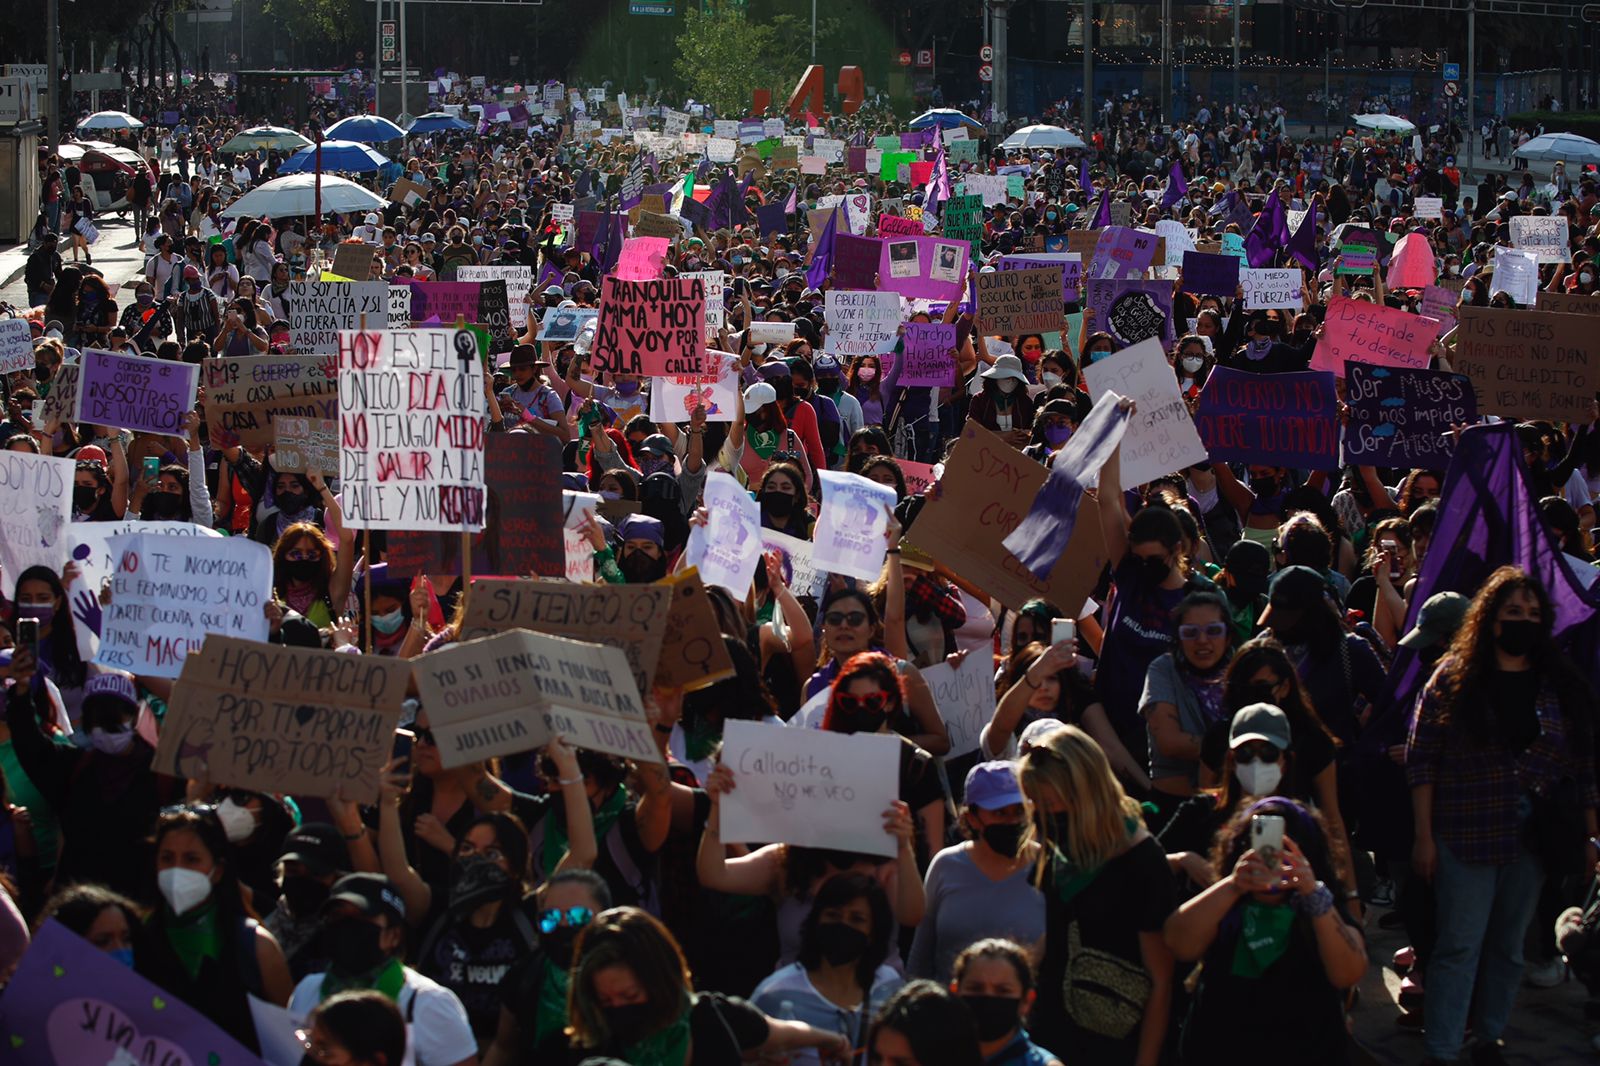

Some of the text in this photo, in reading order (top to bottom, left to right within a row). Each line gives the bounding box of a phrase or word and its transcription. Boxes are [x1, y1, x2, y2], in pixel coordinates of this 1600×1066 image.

[290, 281, 351, 297] NO SOY TU
[607, 276, 704, 303] TRANQUILA
[979, 273, 1019, 290] QUIERO
[291, 296, 356, 315] MAMACITA
[834, 294, 876, 307] ABUELITA
[1024, 299, 1063, 314] LOGROS
[1253, 290, 1291, 304] FUERZA
[290, 315, 354, 330] LO FUERA TE
[660, 302, 701, 329] HOY
[834, 308, 857, 320] VINE
[857, 308, 864, 320] A
[1340, 303, 1415, 343] Defiende
[597, 323, 618, 349] NO
[676, 329, 699, 346] POR
[906, 324, 953, 343] Marcho
[1504, 319, 1555, 341] CHISTES
[338, 331, 456, 371] HOY ES EL
[593, 346, 703, 374] SOLA CALLE
[682, 344, 696, 358] LA
[1531, 344, 1549, 361] NO
[1556, 346, 1588, 365] DAN
[1350, 367, 1383, 402] Ser
[1496, 363, 1586, 388] CALLADITO
[246, 384, 276, 403] CASA
[285, 382, 296, 398] Y
[302, 381, 321, 396] EN
[340, 370, 481, 413] ÚNICO DÍA QUE
[92, 400, 112, 420] DE
[223, 410, 260, 431] CASA
[1379, 407, 1407, 426] nos
[1413, 403, 1466, 428] impide
[342, 413, 368, 449] NO
[371, 412, 434, 449] TENGO
[434, 414, 485, 453] MIEDO
[1347, 423, 1385, 455] Ser
[342, 449, 483, 483] DE SALIR A LA
[971, 447, 1032, 495] STAY
[341, 483, 437, 522] CALLE Y NO
[118, 550, 139, 573] NO
[152, 552, 173, 573] TE
[114, 579, 130, 595] EL
[234, 589, 258, 608] NO
[488, 588, 622, 626] SI TENGO
[200, 612, 225, 630] QUE
[105, 627, 142, 649] FINAL
[217, 647, 388, 709] HOY MARCHO
[432, 668, 457, 689] YO
[464, 663, 483, 681] SI
[495, 652, 552, 676] TENGO
[443, 677, 522, 709] OVARIOS
[533, 674, 575, 700] PARA
[214, 693, 265, 734] POR
[455, 720, 529, 753] JUSTICIA
[586, 718, 653, 755] TODAS
[232, 735, 367, 780] POR TODAS
[739, 748, 835, 780] Calladita
[824, 786, 856, 801] VEO
